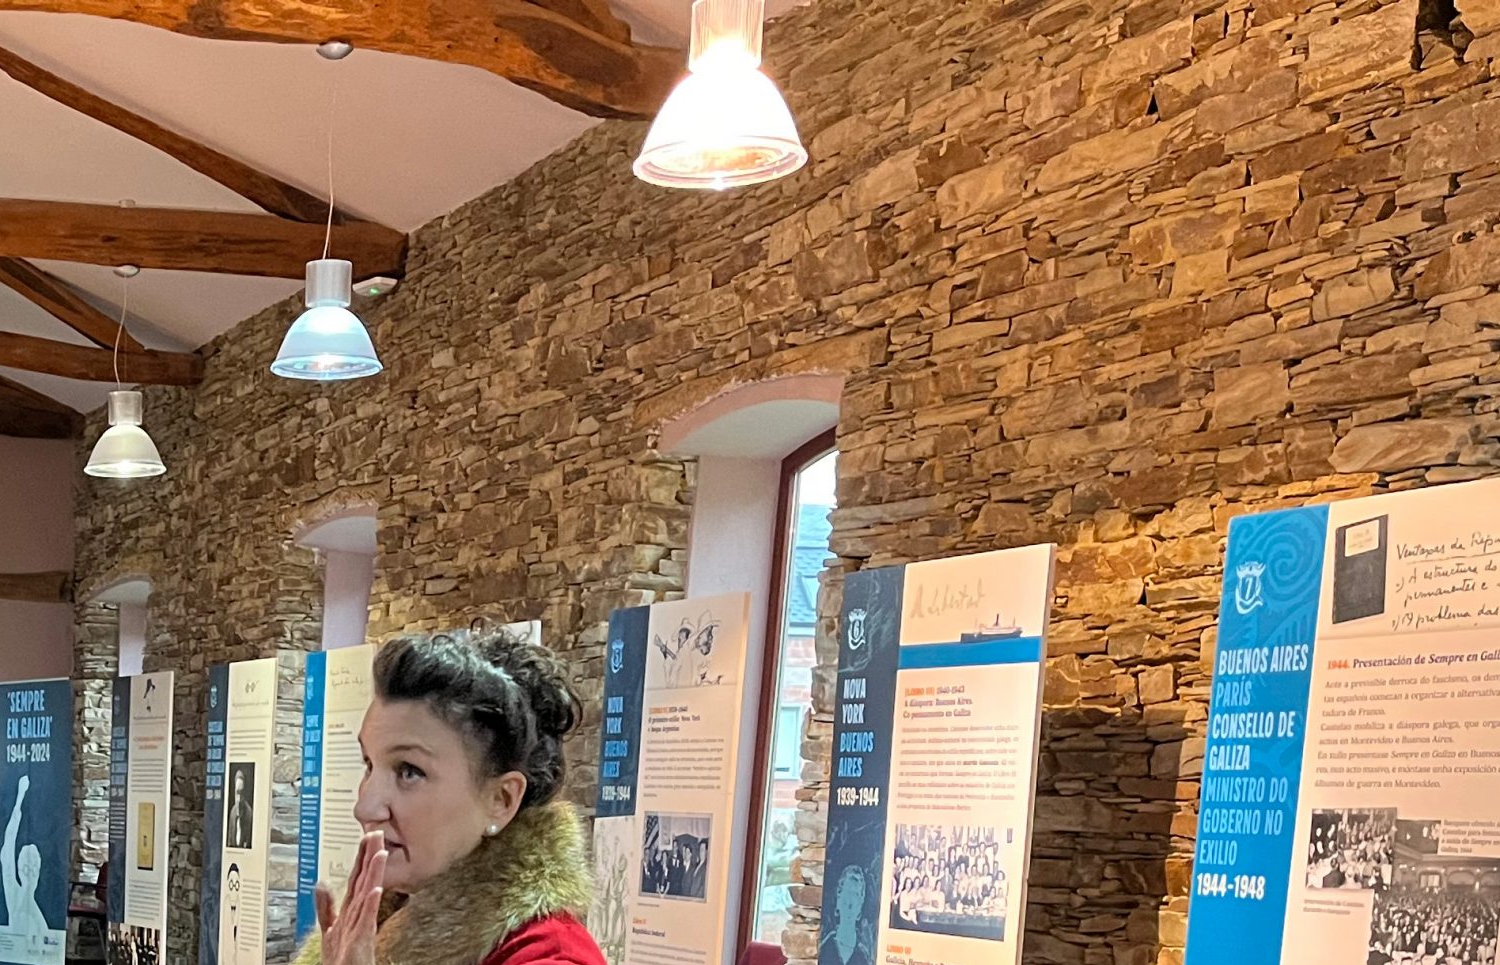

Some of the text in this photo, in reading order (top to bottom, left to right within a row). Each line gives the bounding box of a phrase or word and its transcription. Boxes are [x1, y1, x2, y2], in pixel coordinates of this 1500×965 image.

[1218, 644, 1309, 677] BUENOS AIRES
[1327, 659, 1350, 670] 1944.
[1353, 655, 1412, 669] Presentación
[1414, 654, 1426, 664] de
[1428, 653, 1464, 666] Sempre
[1466, 653, 1478, 662] en
[843, 678, 867, 699] NOVA
[1215, 679, 1252, 708] PARÍS
[842, 703, 865, 724] YORK
[1212, 711, 1296, 740] CONSELLO DE
[7, 718, 18, 739] EN
[7, 743, 50, 763] 1944-2024
[840, 732, 874, 752] BUENOS
[838, 757, 863, 777] AIRES
[1209, 744, 1250, 771] GALIZA
[837, 786, 880, 806] 1939-1944
[1205, 776, 1289, 803] MINISTRO DO
[1202, 808, 1284, 836] GOBERNO NO
[1199, 839, 1238, 867] EXILIO
[1196, 871, 1266, 902] 1944-1948
